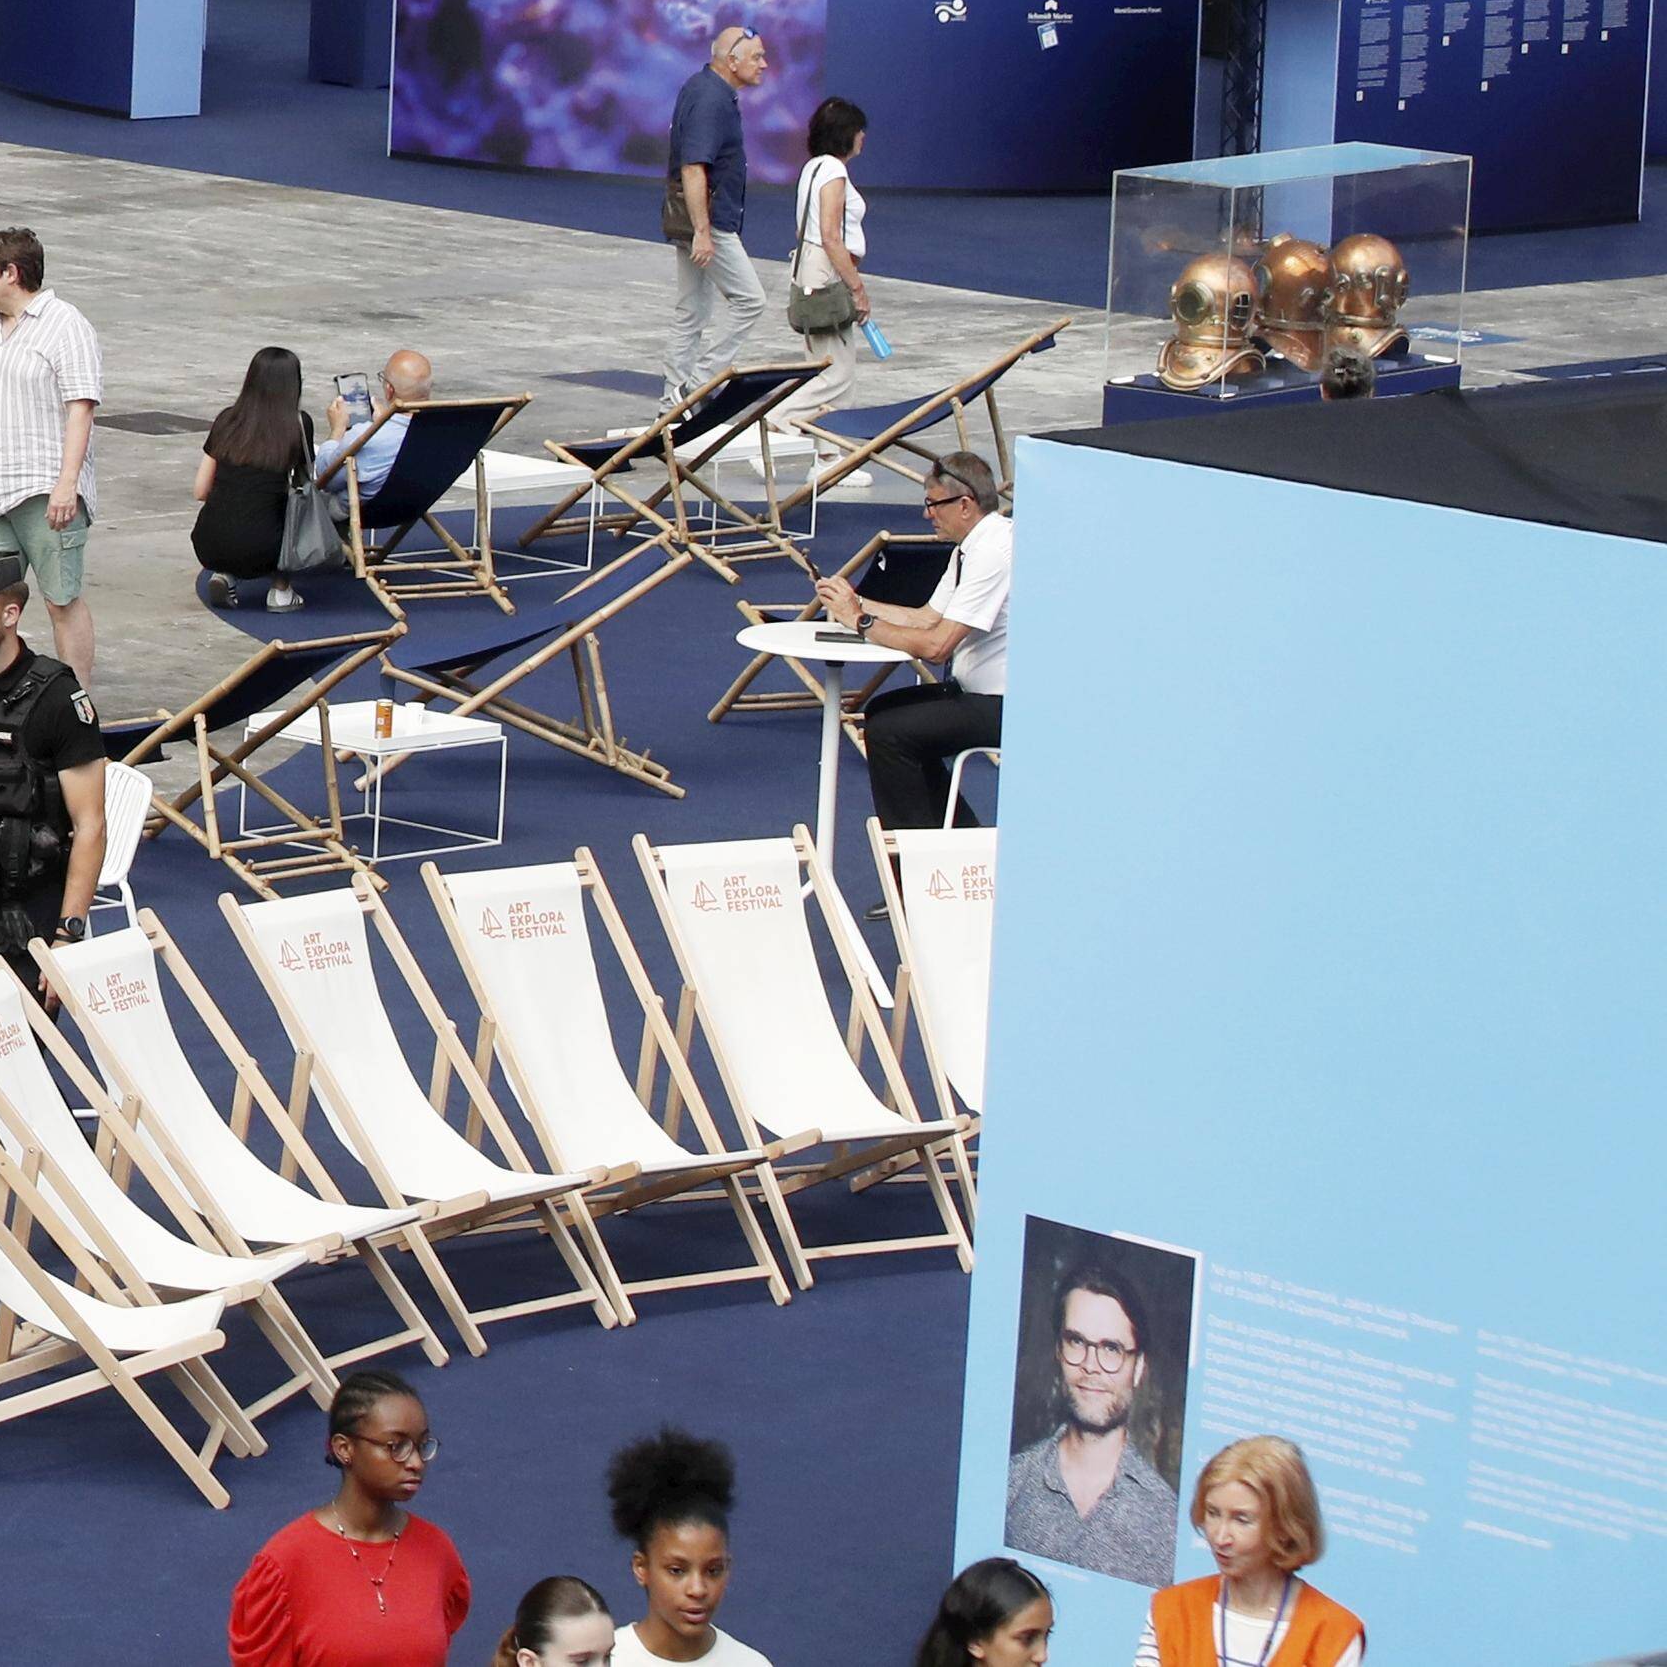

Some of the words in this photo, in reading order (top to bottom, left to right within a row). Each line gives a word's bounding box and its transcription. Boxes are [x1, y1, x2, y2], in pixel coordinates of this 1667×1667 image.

[962, 865, 987, 877] ART
[723, 875, 747, 888] ART
[963, 874, 994, 888] EXPL
[725, 884, 782, 901] EXPLORA
[964, 886, 995, 901] FEST
[507, 901, 531, 915] ART
[727, 897, 783, 913] FESTIVAL
[509, 909, 565, 928] EXPLORA
[511, 921, 567, 940] FESTIVAL
[302, 932, 322, 946] ART
[304, 940, 351, 959] EXPLORA
[308, 953, 353, 971] FESTIVAL
[106, 972, 122, 988] ART
[110, 981, 147, 1000] EXPLORA
[113, 993, 150, 1014] FESTIVAL
